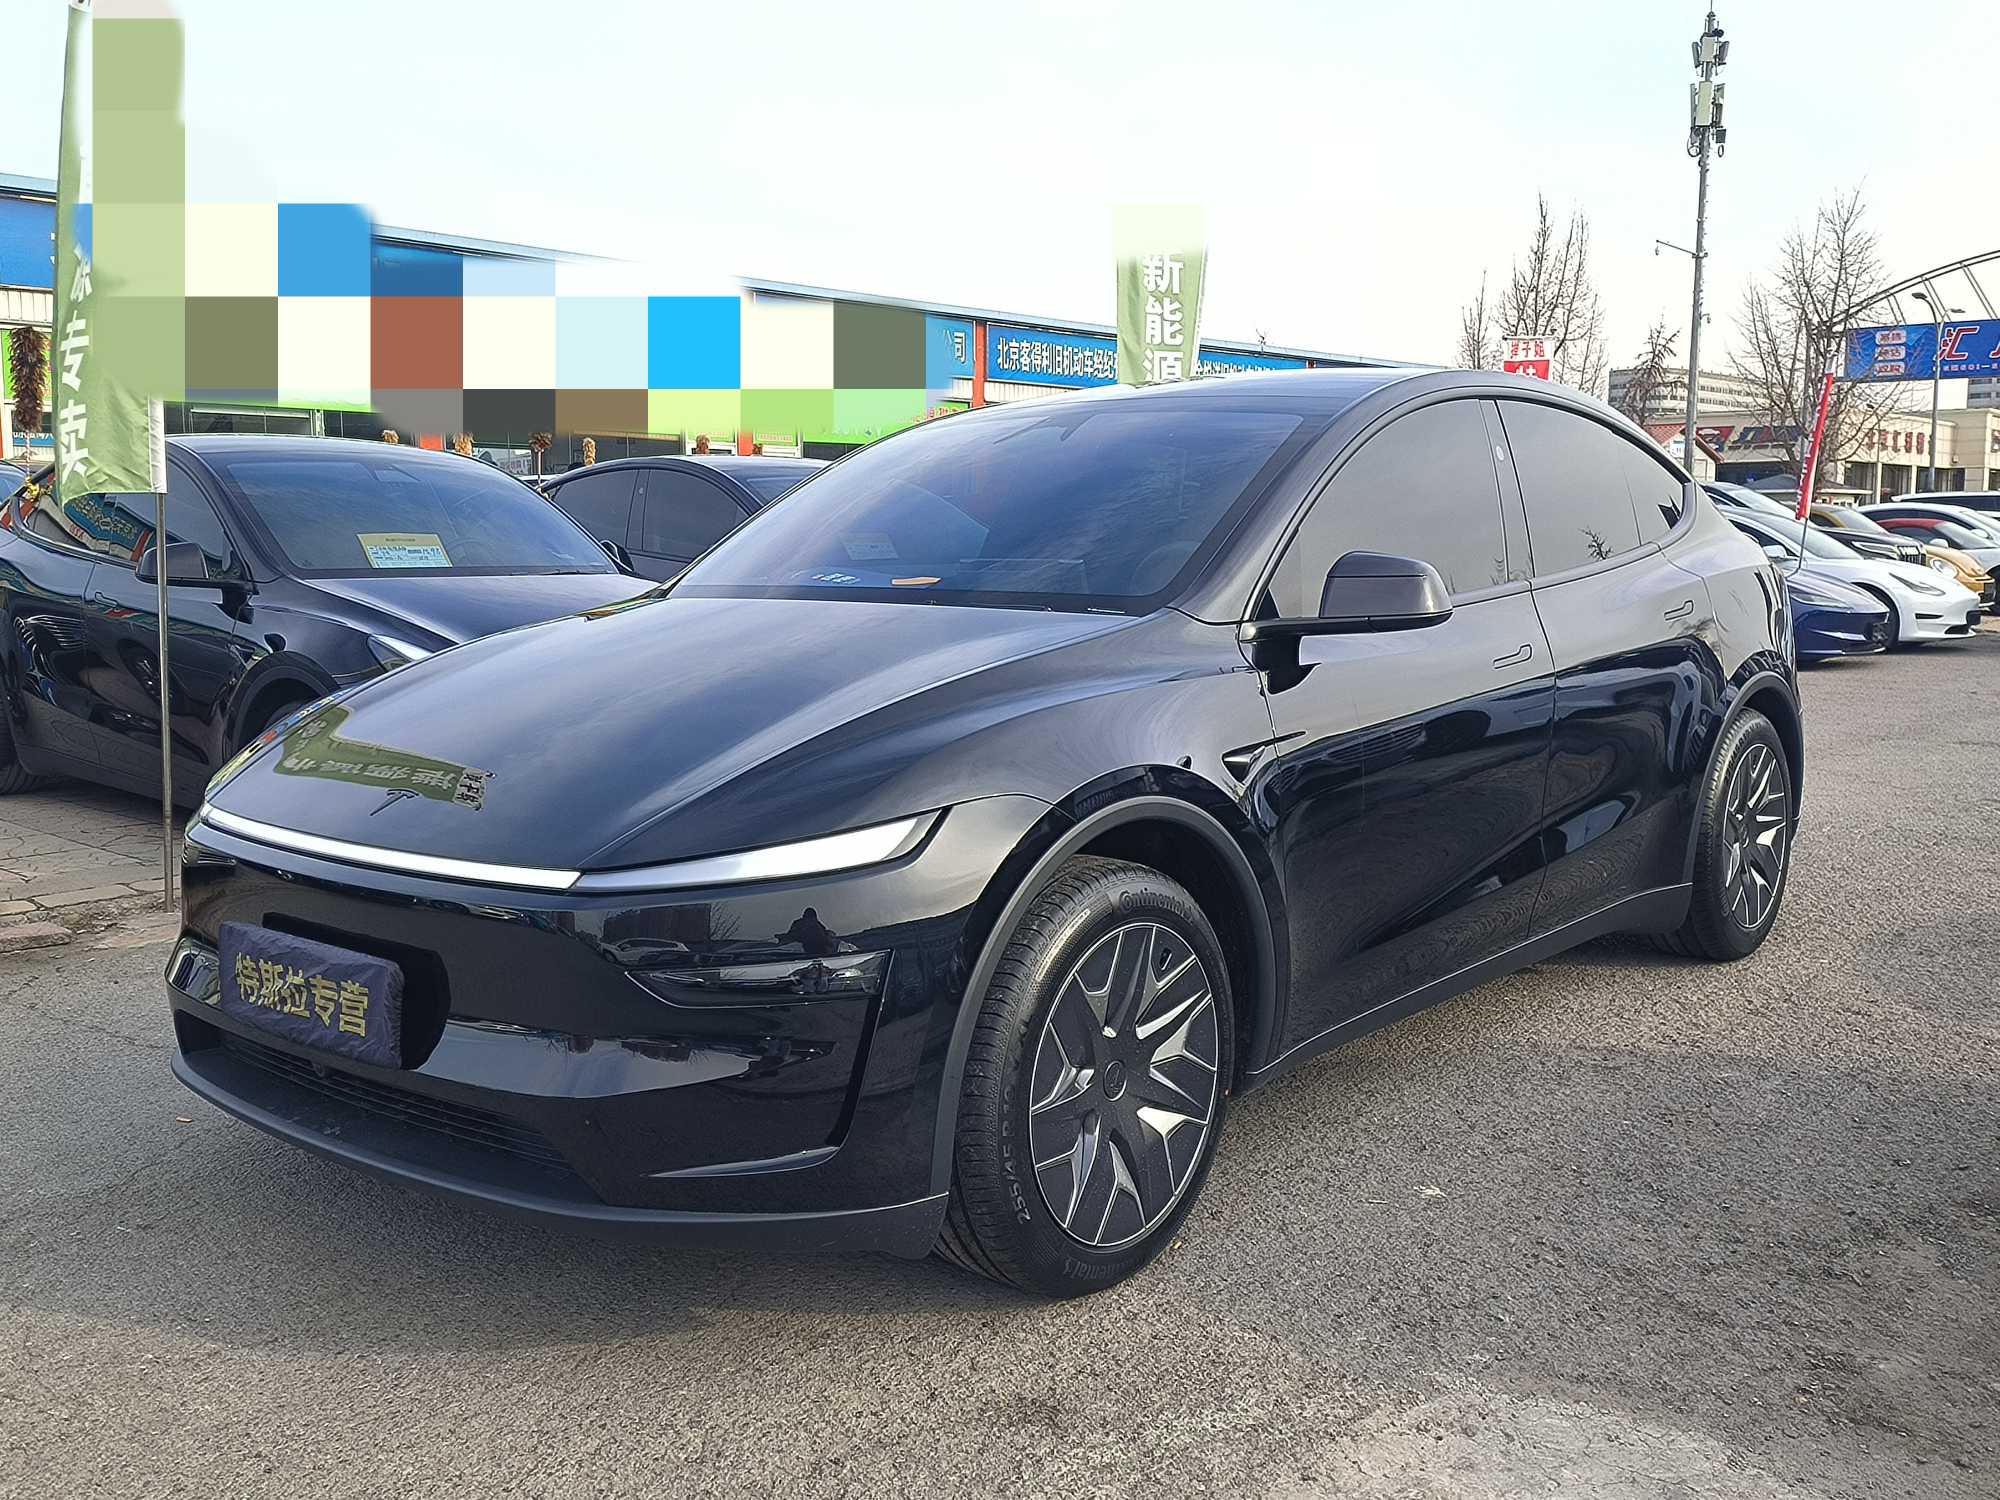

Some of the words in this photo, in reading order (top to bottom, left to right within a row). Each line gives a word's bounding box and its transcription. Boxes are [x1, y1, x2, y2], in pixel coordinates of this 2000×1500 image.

[944, 330, 967, 364] 司
[997, 337, 1118, 380] 北京客得利旧机动车经纪
[1934, 325, 2000, 361] 汇
[236, 951, 369, 1037] 特斯拉专营
